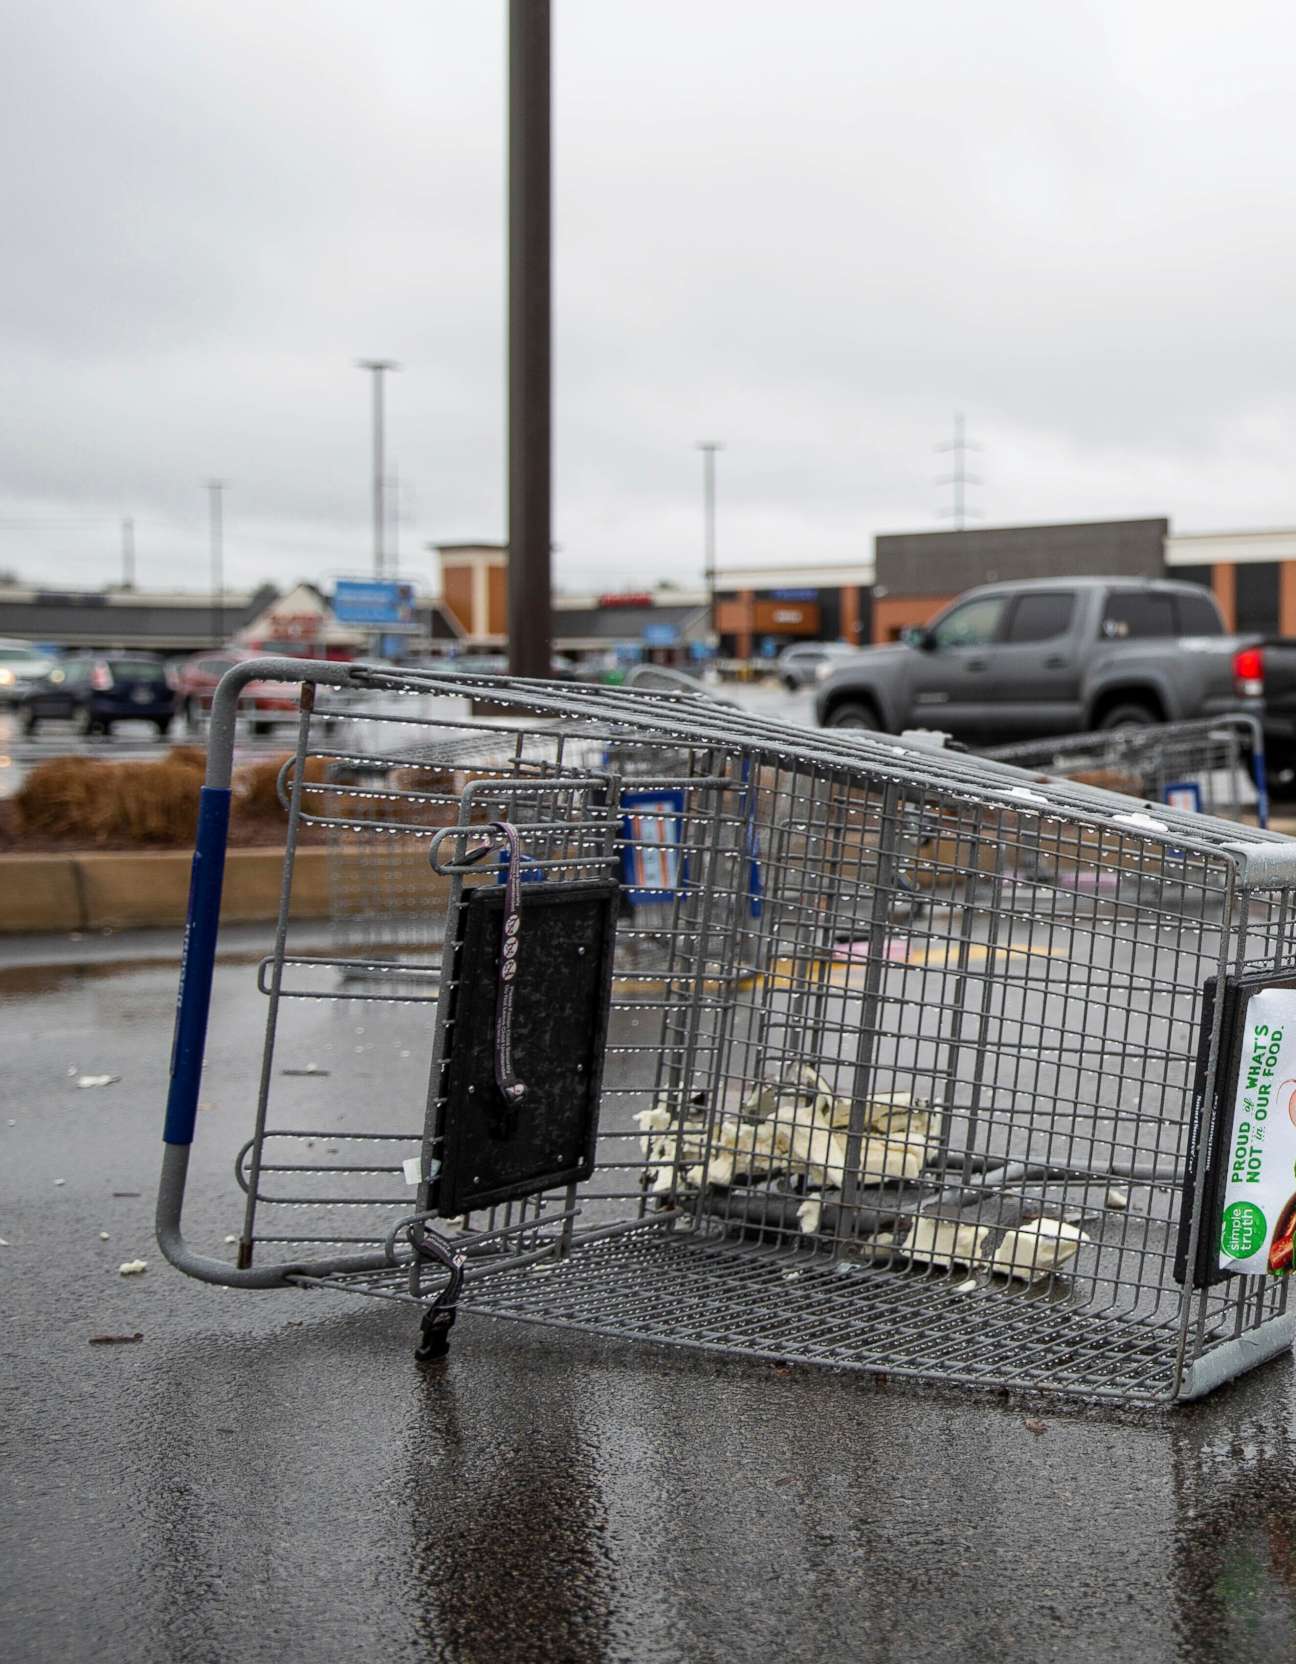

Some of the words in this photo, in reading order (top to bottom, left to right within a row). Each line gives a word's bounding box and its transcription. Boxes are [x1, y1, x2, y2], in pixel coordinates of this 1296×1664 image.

[1246, 1024, 1269, 1089] WHAT'S
[1262, 1025, 1284, 1077] FOOD.
[1243, 1098, 1254, 1112] of
[1255, 1084, 1271, 1121] OUR
[1232, 1122, 1251, 1183] PROUD
[1255, 1127, 1264, 1140] in
[1246, 1146, 1263, 1183] NOT
[1230, 1208, 1242, 1251] simple
[1241, 1208, 1254, 1251] truth
